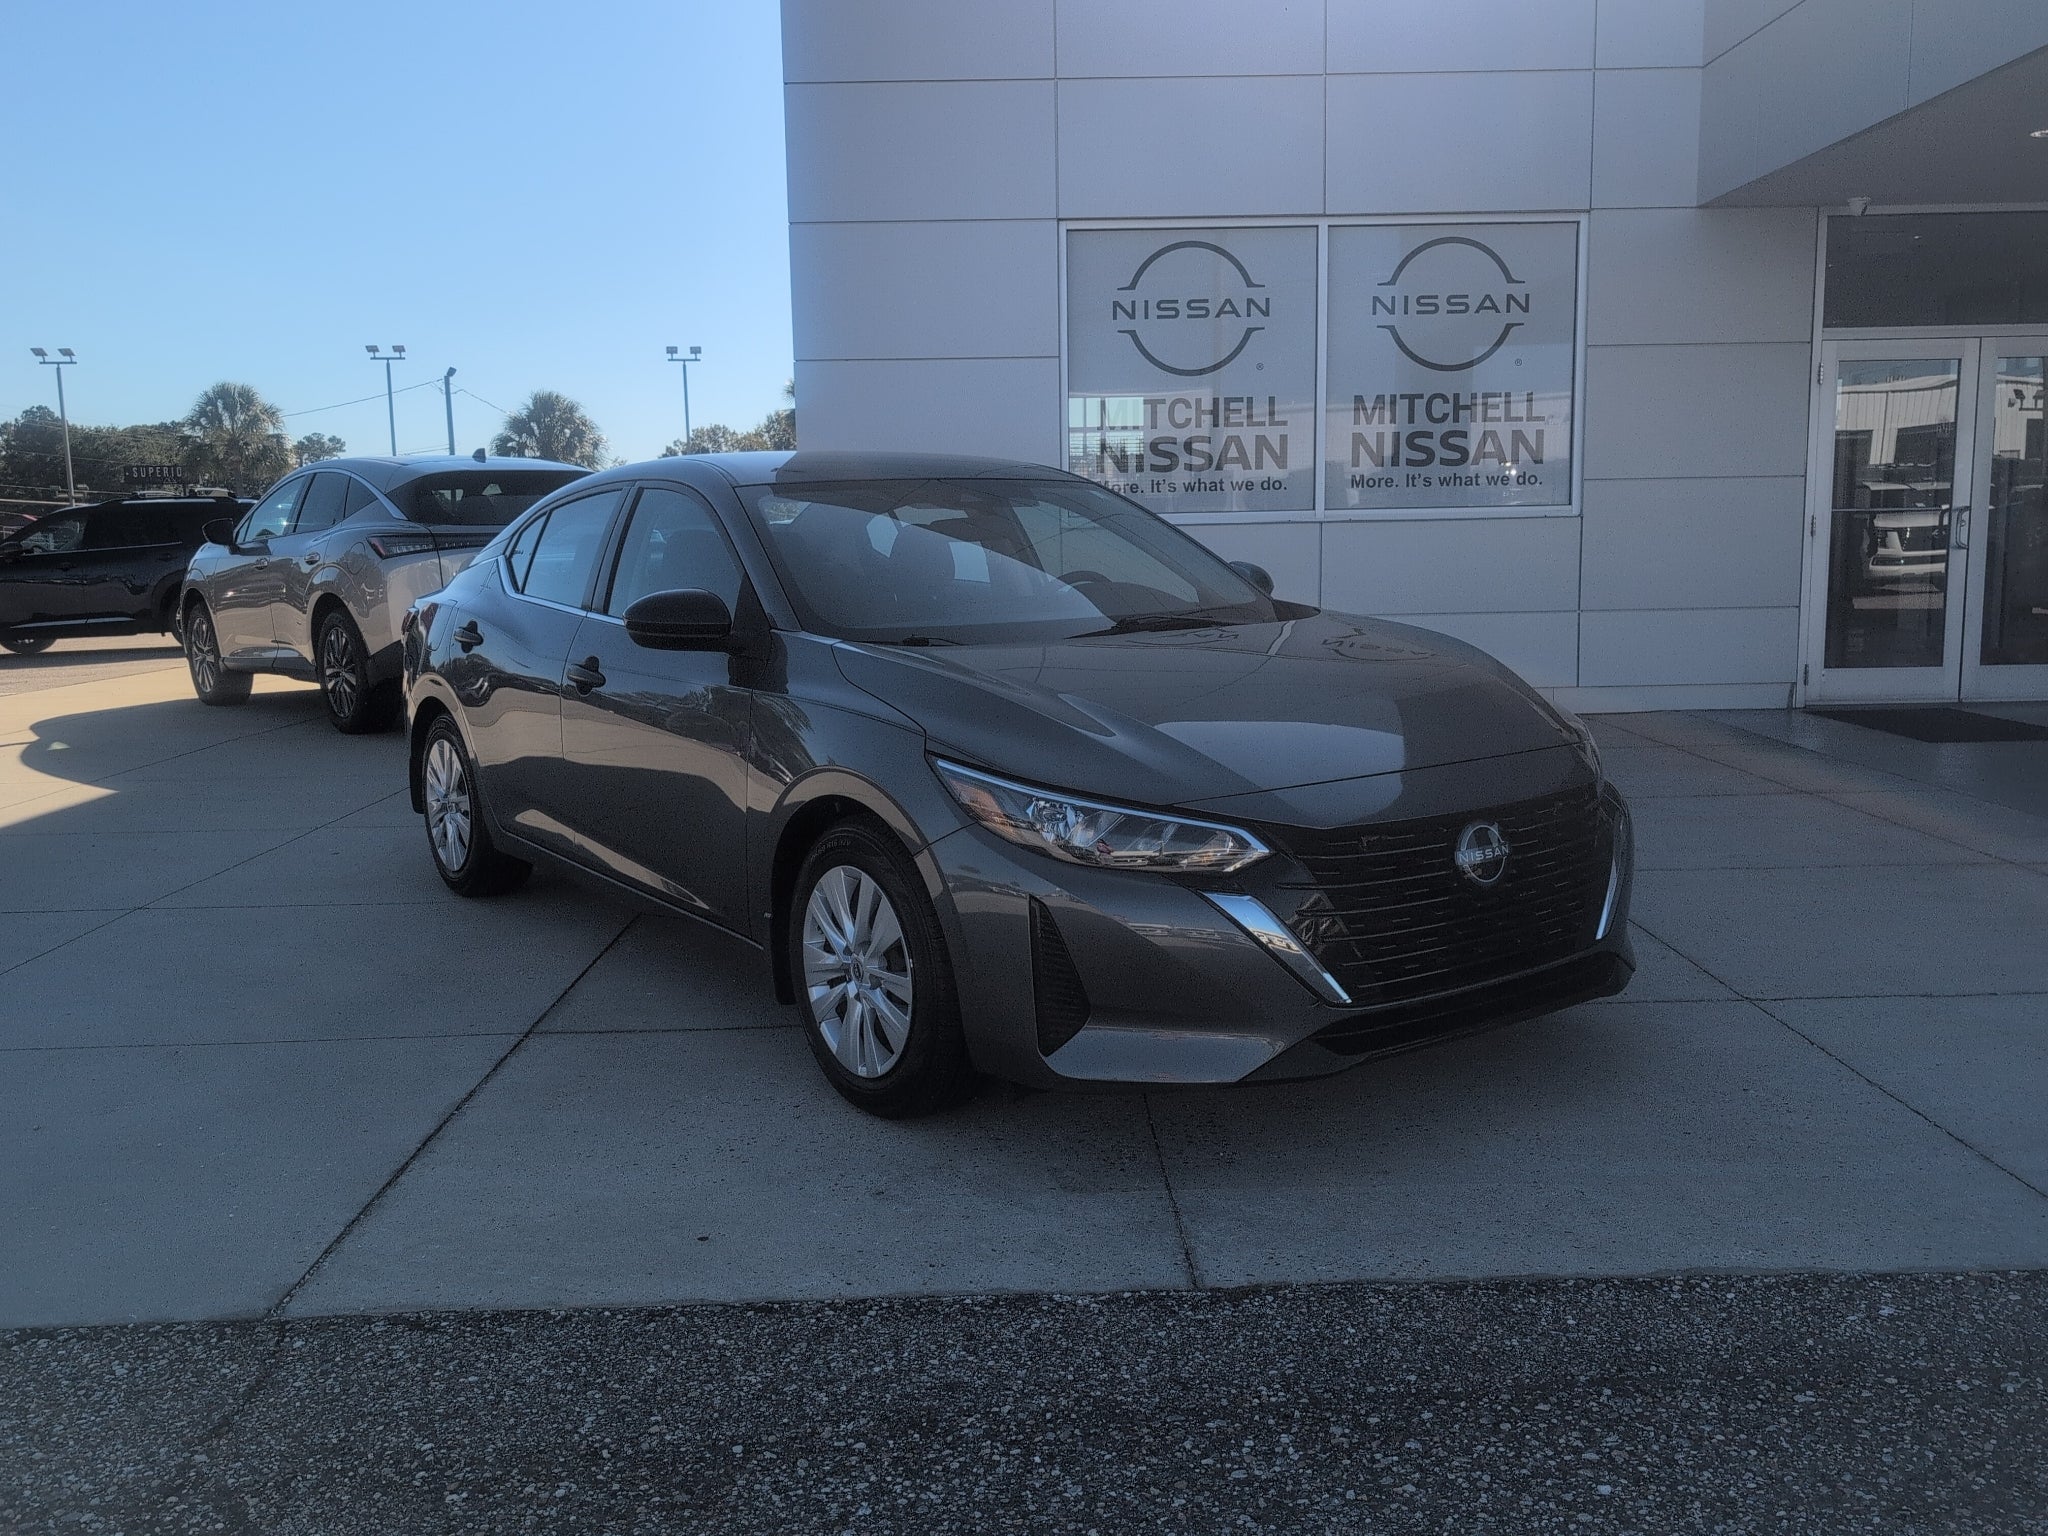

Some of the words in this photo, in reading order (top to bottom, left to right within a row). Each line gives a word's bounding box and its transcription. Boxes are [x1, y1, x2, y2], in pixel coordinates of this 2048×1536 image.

[1112, 297, 1270, 321] NISSAN
[1371, 293, 1530, 316] NISSAN
[1353, 391, 1546, 426] MITCHELL
[1095, 433, 1289, 474] NISSAN
[1351, 429, 1545, 468] NISSAN
[132, 466, 182, 478] SUPERIO
[1350, 474, 1400, 489] More.
[1405, 473, 1432, 488] It's
[1438, 472, 1481, 488] what
[1486, 474, 1510, 487] we
[1516, 471, 1543, 486] do.
[1150, 479, 1177, 493] It's
[1183, 478, 1225, 493] what
[1231, 480, 1255, 492] we
[1260, 476, 1288, 491] do.
[1458, 844, 1509, 862] NISSAN
